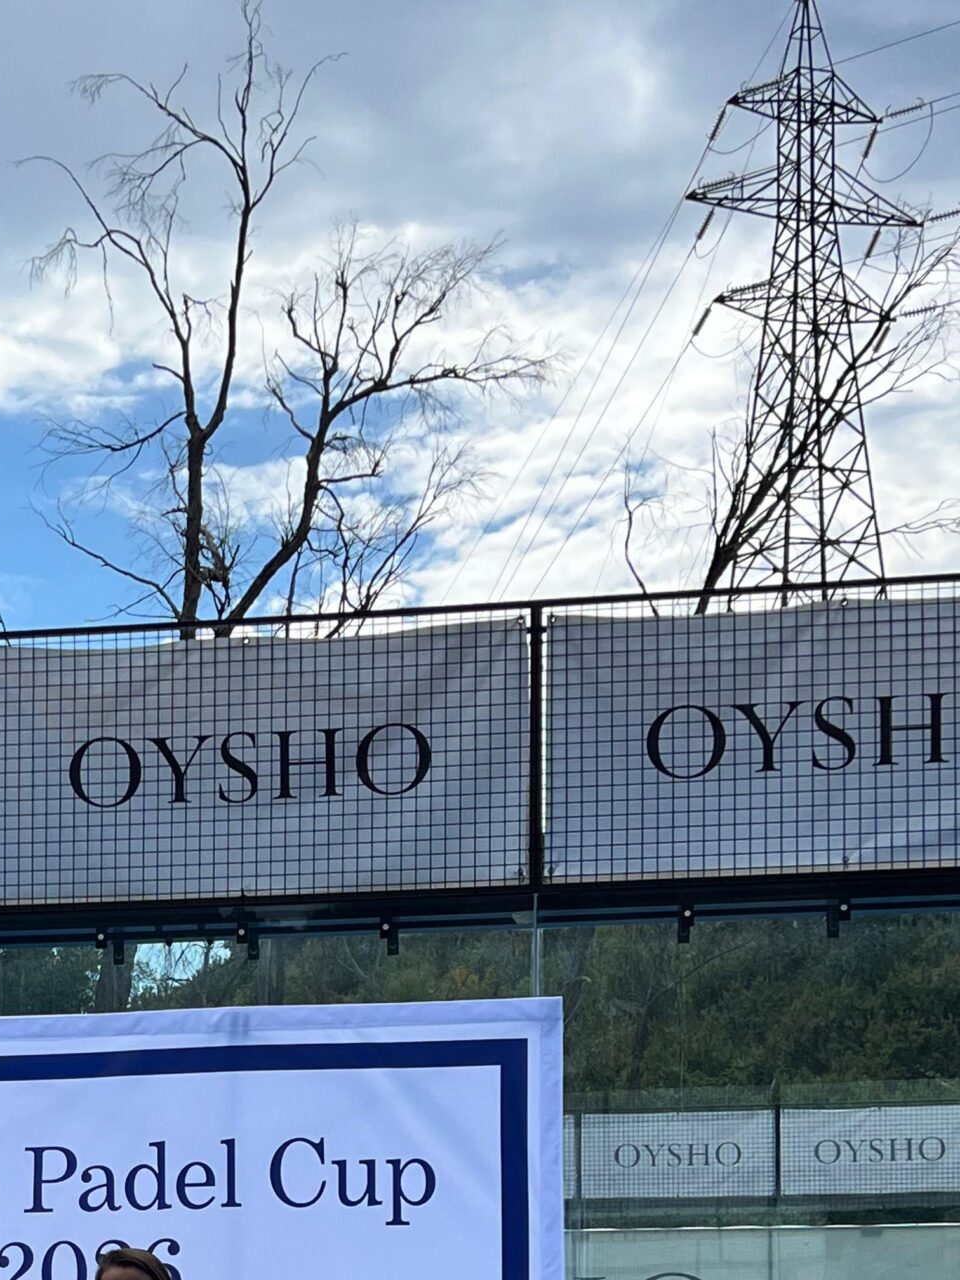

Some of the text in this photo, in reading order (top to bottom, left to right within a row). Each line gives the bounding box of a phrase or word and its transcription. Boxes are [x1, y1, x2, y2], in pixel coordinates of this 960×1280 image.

[68, 722, 433, 808] OYSHO
[646, 693, 951, 780] OYSH
[23, 1137, 242, 1214] Padel
[269, 1136, 436, 1226] Cup
[614, 1141, 742, 1169] OYSHO
[813, 1136, 947, 1165] OYSHO
